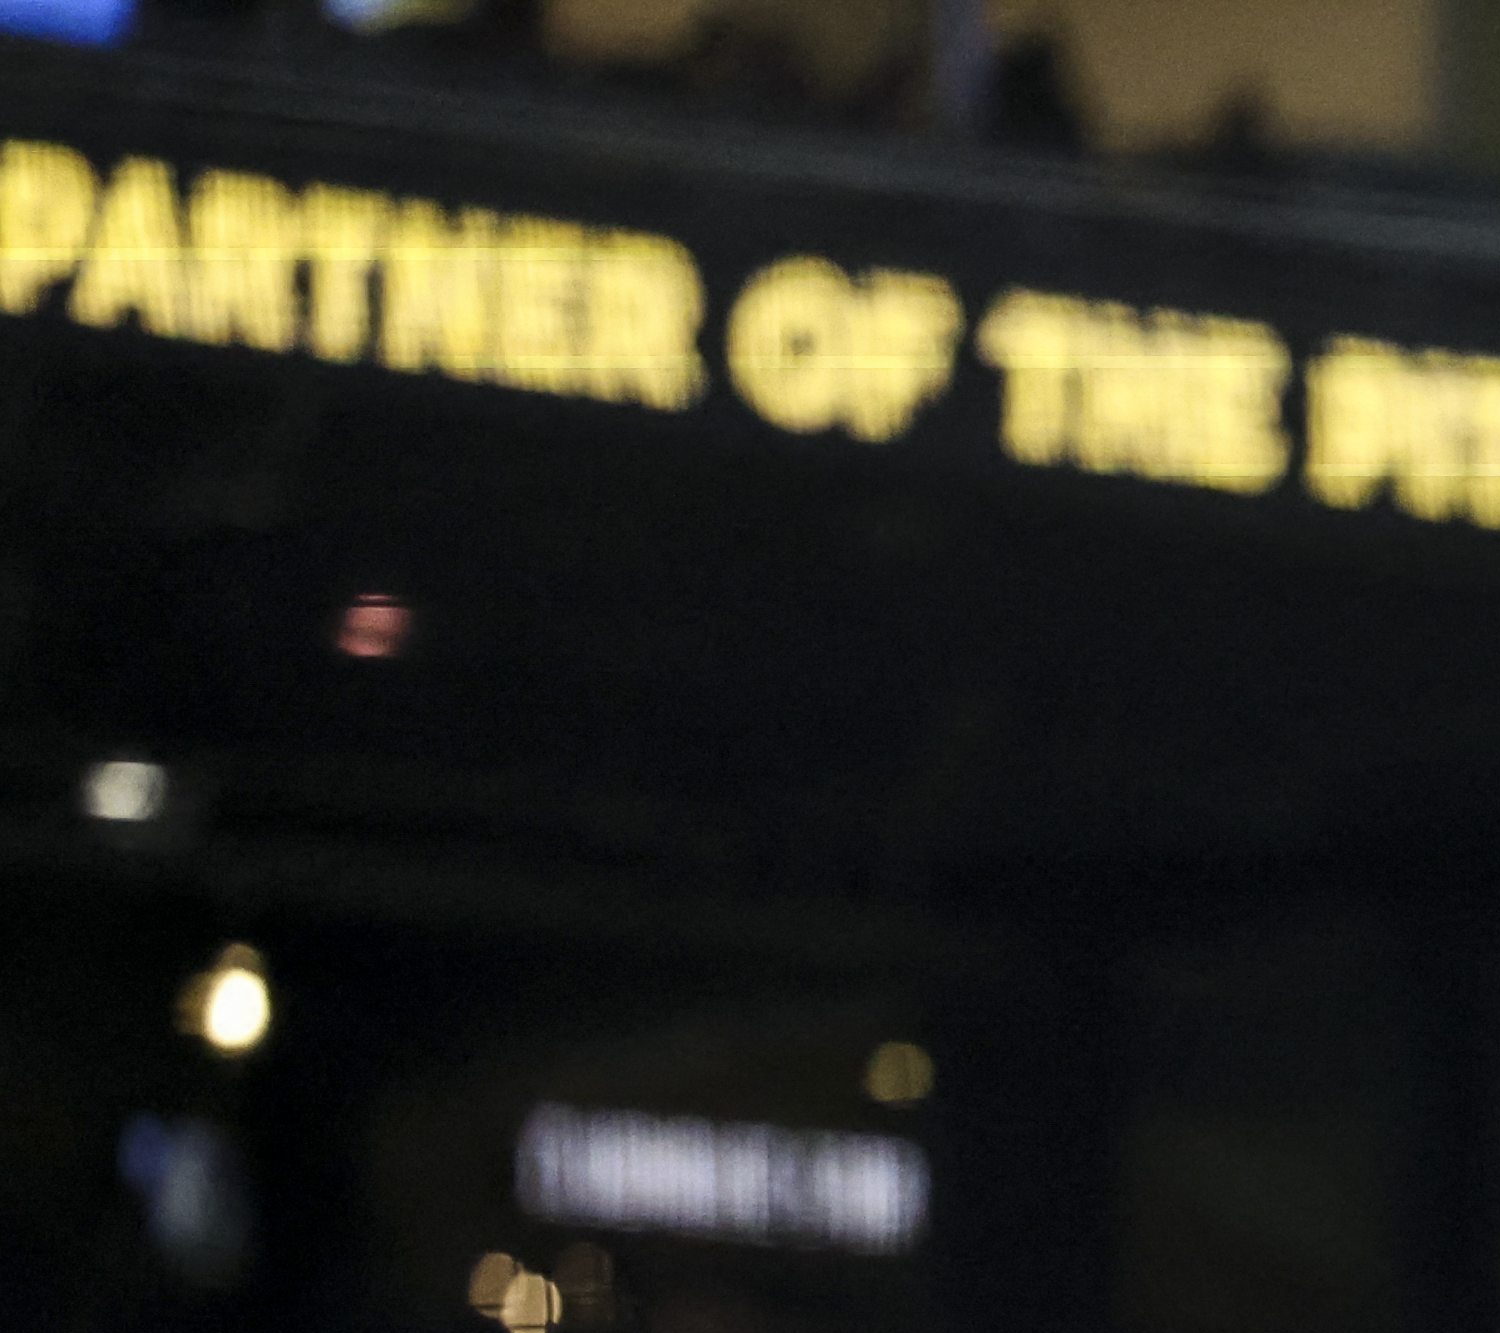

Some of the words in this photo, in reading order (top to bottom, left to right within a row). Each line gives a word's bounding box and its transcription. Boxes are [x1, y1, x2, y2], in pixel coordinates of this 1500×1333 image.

[0, 138, 708, 412] PARTNER
[726, 254, 964, 442] OF
[976, 286, 1292, 496] THE
